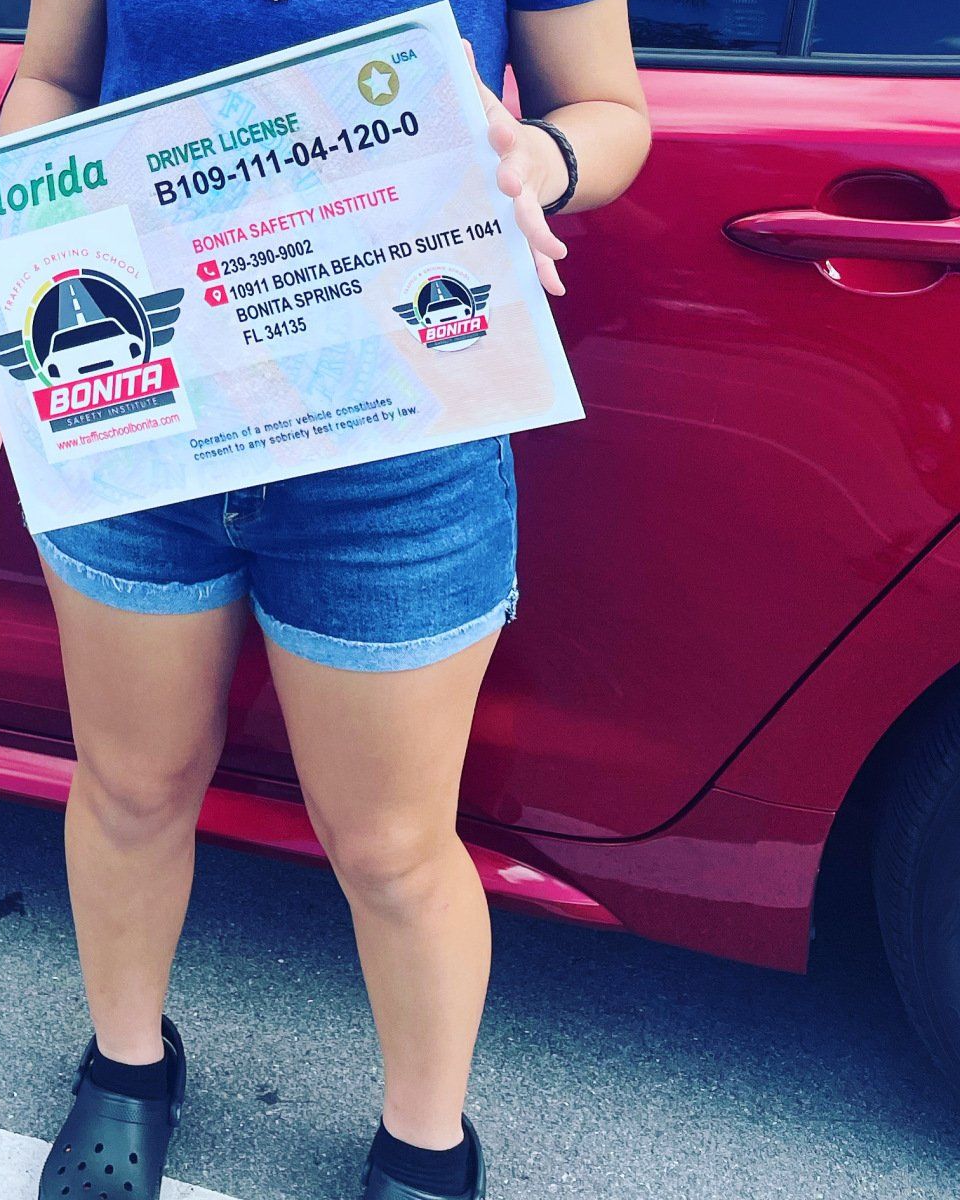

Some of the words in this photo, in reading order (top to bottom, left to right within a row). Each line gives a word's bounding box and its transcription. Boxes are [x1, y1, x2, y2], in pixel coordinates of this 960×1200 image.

[392, 49, 417, 65] USA
[146, 137, 216, 173] DRIVER
[219, 112, 301, 152] LICENSE
[154, 111, 420, 206] B109-111-04-120-0
[192, 227, 248, 254] BONITA
[249, 208, 316, 238] SAFETTY
[319, 186, 399, 220] INSTITUTE
[4, 271, 32, 311] TRAFFIC
[34, 263, 41, 272] &
[43, 248, 90, 266] DRIVING
[95, 250, 141, 280] SCHOOL
[221, 239, 313, 276] 239-390-9002
[230, 278, 269, 300] 10911
[272, 263, 330, 290] BONITA
[331, 248, 386, 275] BEACH
[388, 241, 412, 261] RD
[415, 228, 463, 254] SUITE
[466, 218, 502, 241] 1041
[236, 296, 292, 323] BONITA
[294, 279, 363, 309] SPRINGS
[243, 328, 263, 346] FL
[265, 317, 307, 340] 34135
[426, 317, 482, 341] BONITA
[49, 363, 163, 417] BONITA
[66, 411, 103, 427] SAFETY
[107, 398, 158, 417] INSTITUTE
[56, 413, 181, 450] www.trafficschoolbonita.com
[189, 431, 239, 450] Operation
[241, 426, 252, 438] of
[254, 426, 261, 434] a
[264, 418, 292, 433] motor
[295, 409, 332, 425] vehicle
[335, 397, 393, 416] constitutes
[193, 444, 234, 461] consent
[235, 443, 245, 452] to
[248, 439, 267, 449] any
[269, 427, 310, 445] sobriety
[312, 423, 333, 436] test
[335, 413, 379, 430] required
[382, 411, 395, 422] by
